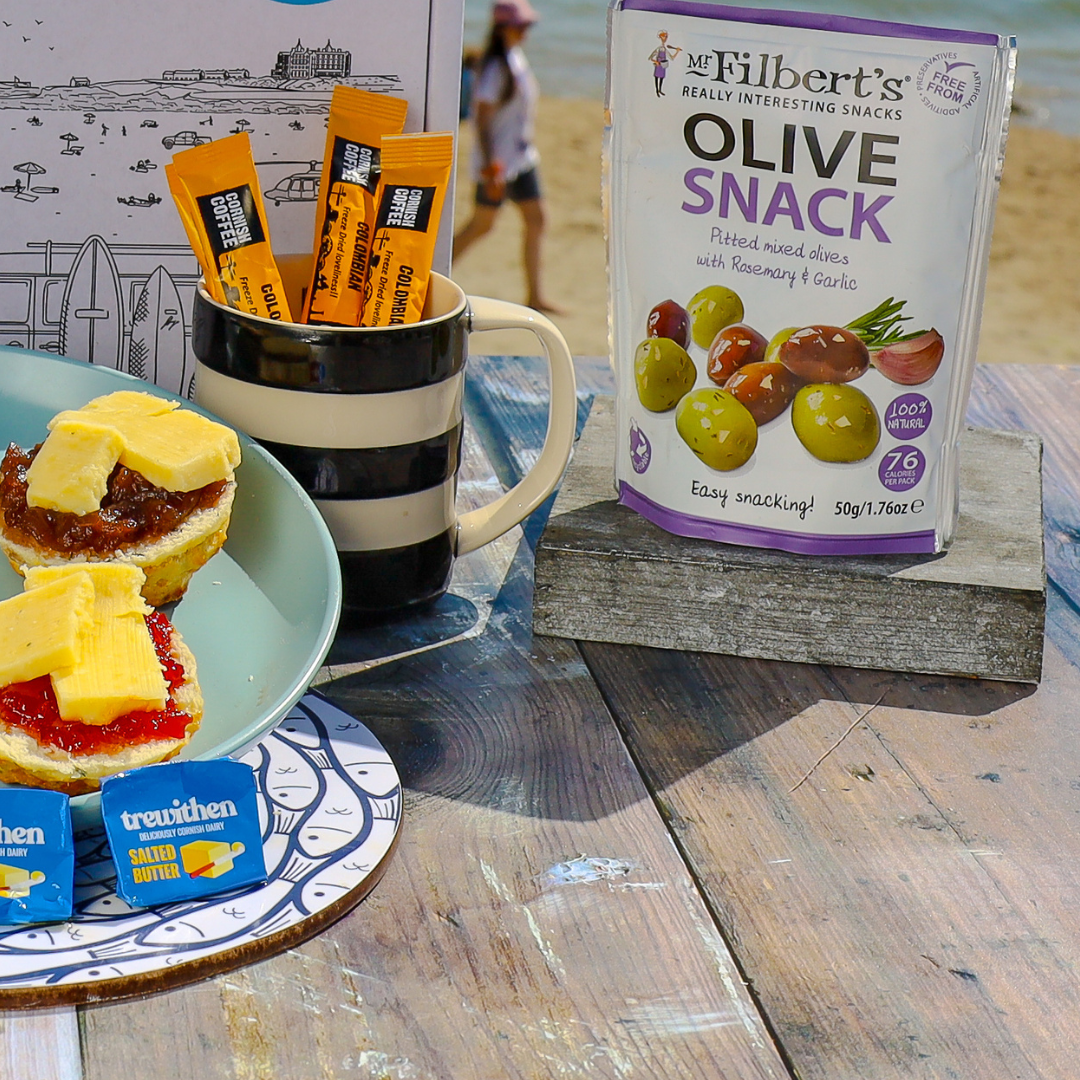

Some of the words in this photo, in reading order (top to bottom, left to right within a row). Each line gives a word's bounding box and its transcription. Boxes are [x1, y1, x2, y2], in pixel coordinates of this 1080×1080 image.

[710, 49, 904, 102] Filbert's
[916, 52, 958, 90] PRESERVATIVES
[932, 71, 967, 92] FREE
[682, 86, 733, 102] REALLY
[738, 92, 836, 114] INTERESTING
[842, 104, 902, 120] SNACKS
[926, 82, 964, 104] FROM
[962, 70, 982, 110] ARTIFICIAL
[920, 96, 960, 116] ADDITIVES
[342, 143, 360, 183] COFFEE
[684, 112, 900, 187] OLIVE
[226, 192, 252, 244] CORNISH
[339, 206, 351, 230] Freeze
[386, 188, 410, 226] COFFEE
[402, 189, 422, 228] CORNISH
[682, 167, 895, 244] SNACK
[210, 196, 238, 248] COFFEE
[335, 230, 348, 252] Dried
[710, 226, 760, 250] Pitted
[763, 239, 806, 258] mixed
[809, 244, 849, 265] olives
[348, 222, 370, 292] COLOMBIAN
[382, 250, 394, 276] Freeze
[696, 253, 725, 270] with
[732, 255, 796, 288] Rosemary
[802, 266, 809, 285] &
[814, 272, 858, 290] Garlic
[240, 276, 254, 306] Freeze
[376, 276, 388, 302] Dried
[389, 265, 414, 326] COLOMBIA
[888, 418, 926, 430] NATURAL
[890, 400, 928, 418] 100%
[885, 470, 916, 478] CALORIES
[886, 451, 919, 471] 76
[885, 478, 897, 486] PER
[898, 477, 916, 485] PACK
[692, 480, 728, 508] Easy
[735, 492, 815, 520] snacking!
[834, 501, 908, 520] 50g/1.76oz
[120, 796, 238, 831] trewithen
[138, 828, 177, 842] DELICIOUSLY
[177, 825, 205, 836] CORNISH
[206, 822, 224, 832] DAIRY
[6, 848, 28, 857] DAIRY
[128, 844, 176, 865] SALTED
[132, 863, 181, 884] BUTTER
